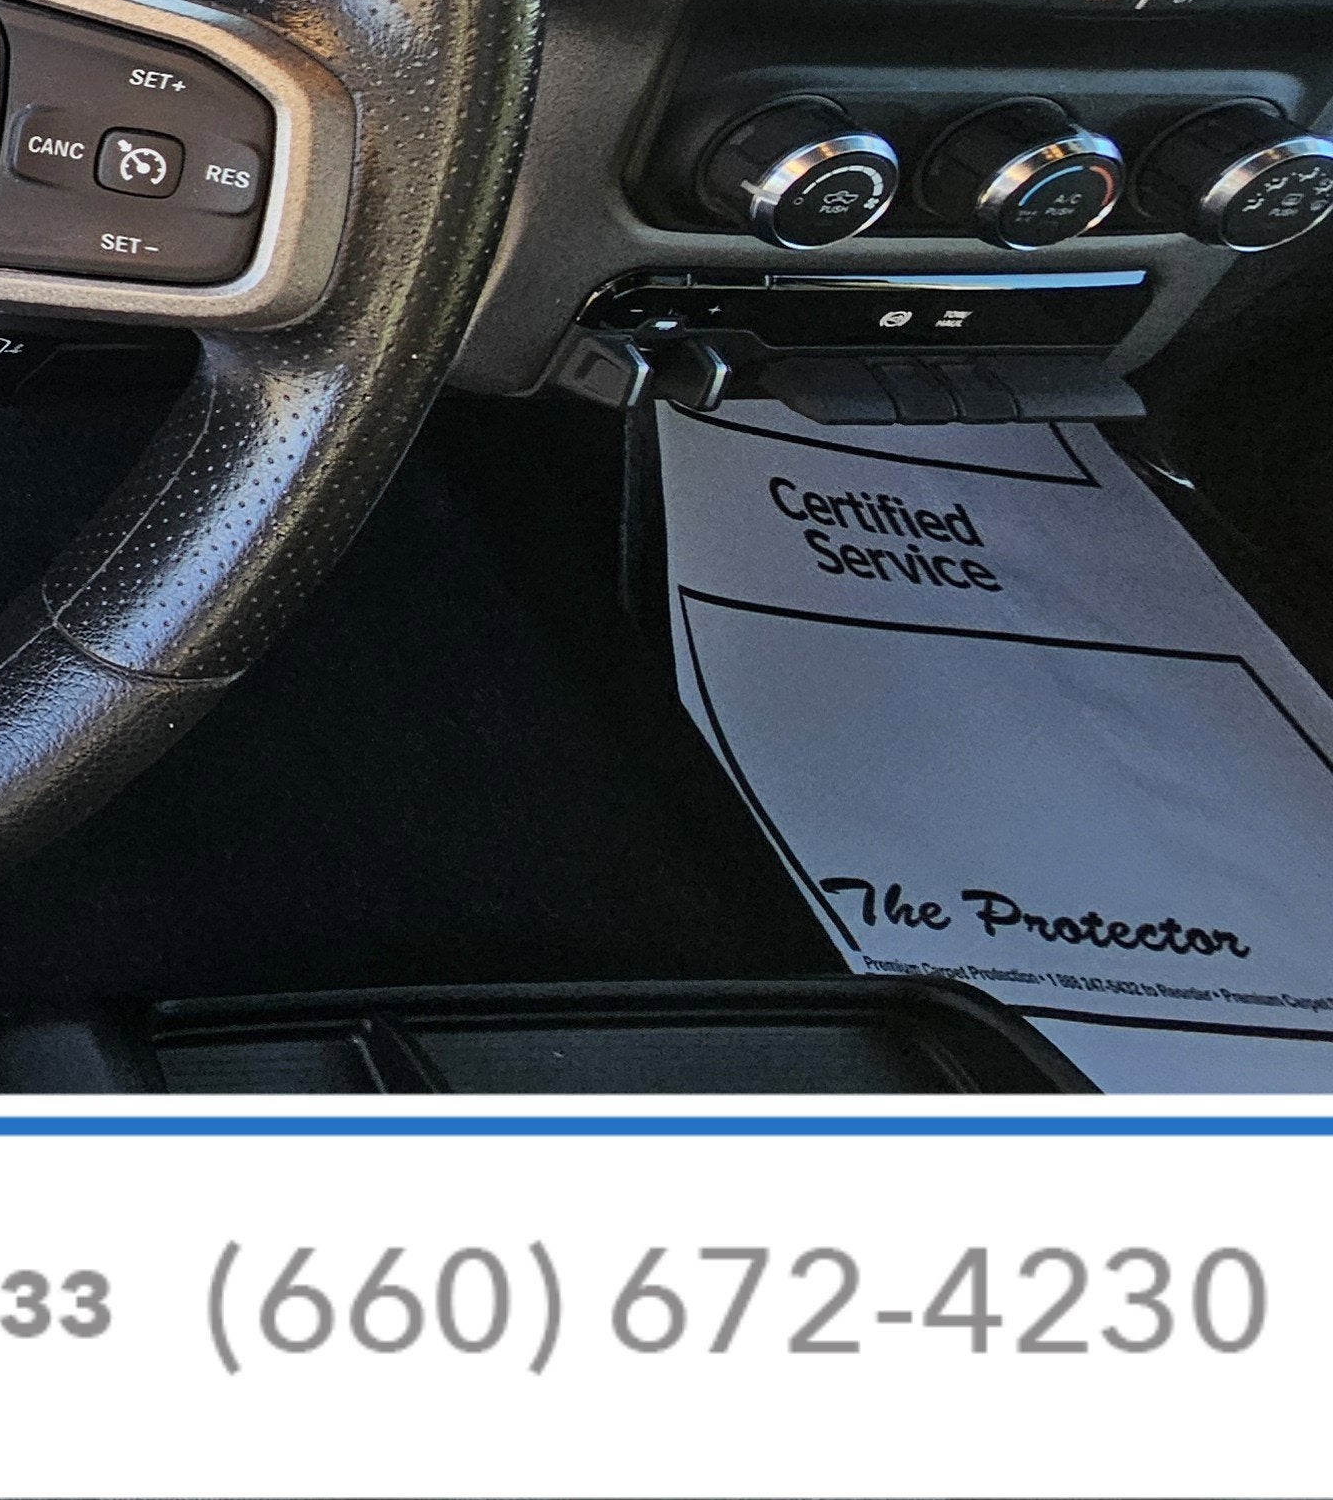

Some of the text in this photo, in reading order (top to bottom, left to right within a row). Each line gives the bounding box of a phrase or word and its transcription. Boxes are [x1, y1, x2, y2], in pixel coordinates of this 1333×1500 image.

[28, 136, 85, 161] CANC
[205, 164, 250, 189] RES
[768, 476, 983, 548] Certified
[803, 530, 1003, 593] Service
[819, 875, 1249, 959] The Protector
